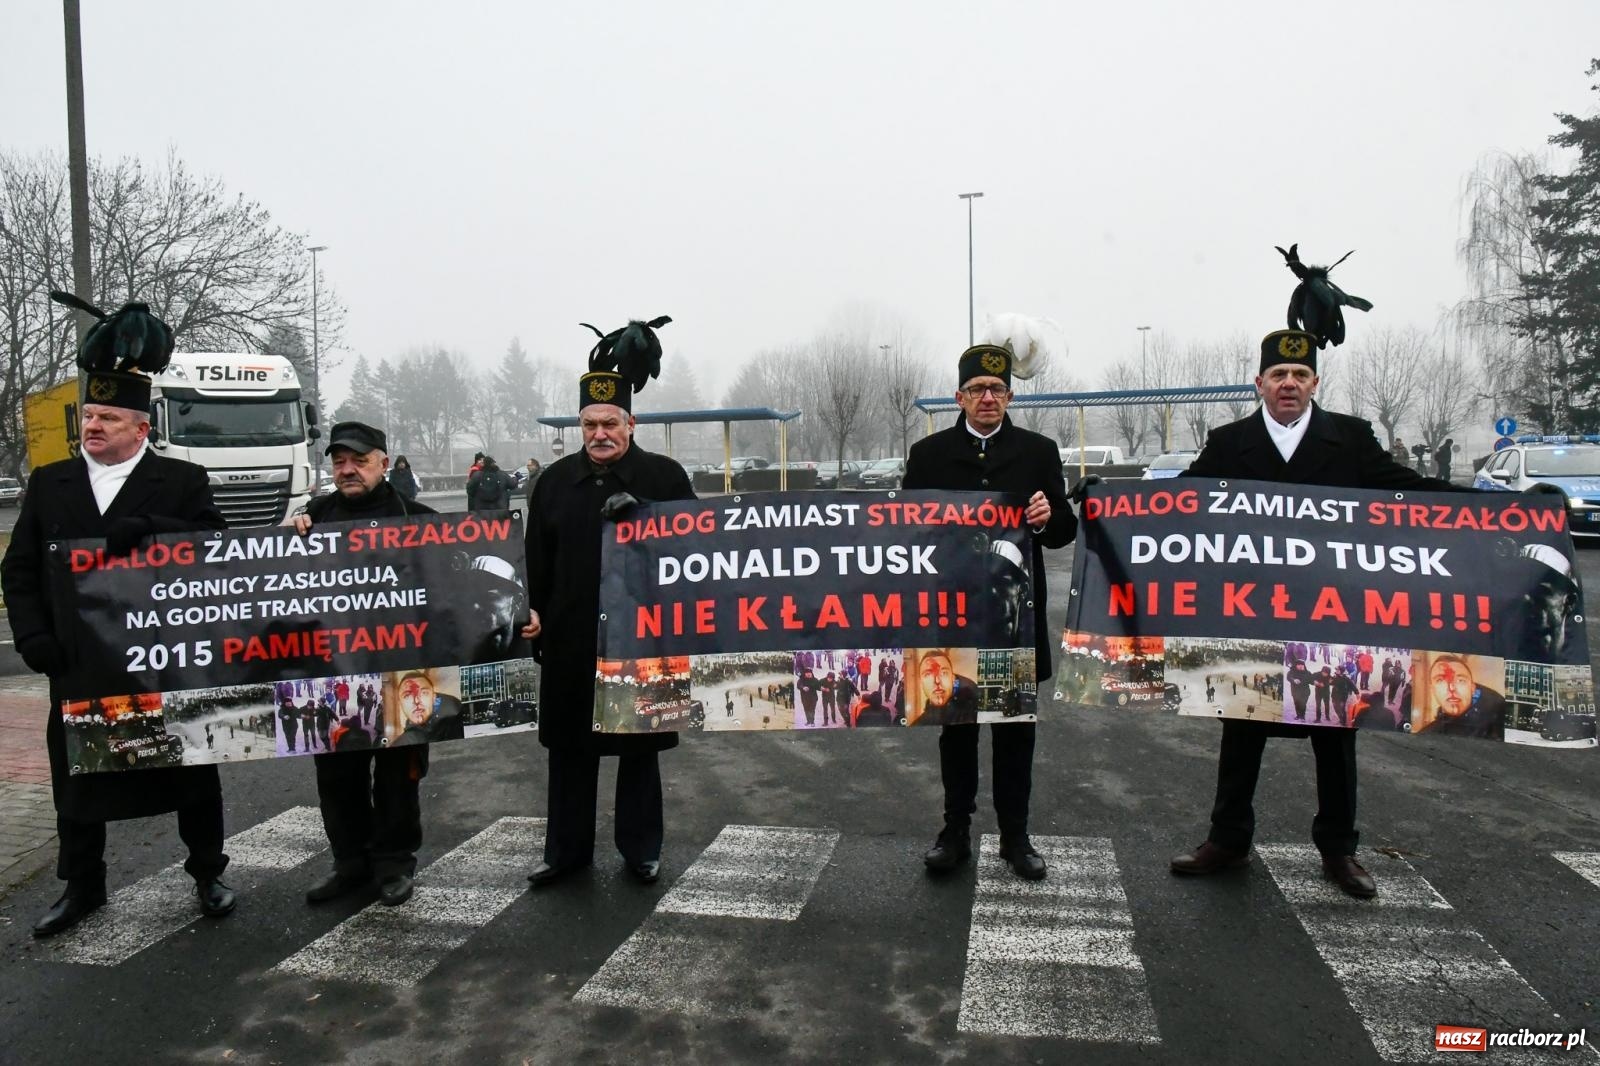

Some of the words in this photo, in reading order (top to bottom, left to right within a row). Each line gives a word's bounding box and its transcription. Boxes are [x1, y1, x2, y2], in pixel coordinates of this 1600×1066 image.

[196, 366, 267, 382] TSLine
[616, 510, 715, 544] DIALOG
[724, 503, 861, 531] ZAMIAST
[867, 499, 1023, 530] STRZAŁÓW
[1086, 490, 1198, 521] DIALOG
[1208, 491, 1360, 523] ZAMIAST
[1368, 500, 1566, 533] STRZAŁÓW
[70, 539, 195, 573] DIALOG
[204, 531, 342, 563] ZAMIAST
[348, 515, 511, 552] STRZAŁÓW
[658, 547, 821, 586] DONALD
[831, 544, 940, 576] TUSK
[1130, 533, 1317, 566] DONALD
[1327, 541, 1453, 577] TUSK
[151, 574, 258, 602] GÓRNICY
[263, 566, 399, 594] ZASŁUGUJĄ
[1108, 581, 1198, 618] NIE
[126, 610, 162, 630] NA
[166, 602, 253, 627] GODNE
[257, 589, 428, 619] TRAKTOWANIE
[635, 599, 717, 639] NIE
[126, 640, 213, 672] 2015
[223, 623, 430, 663] PAMIĘTAMY
